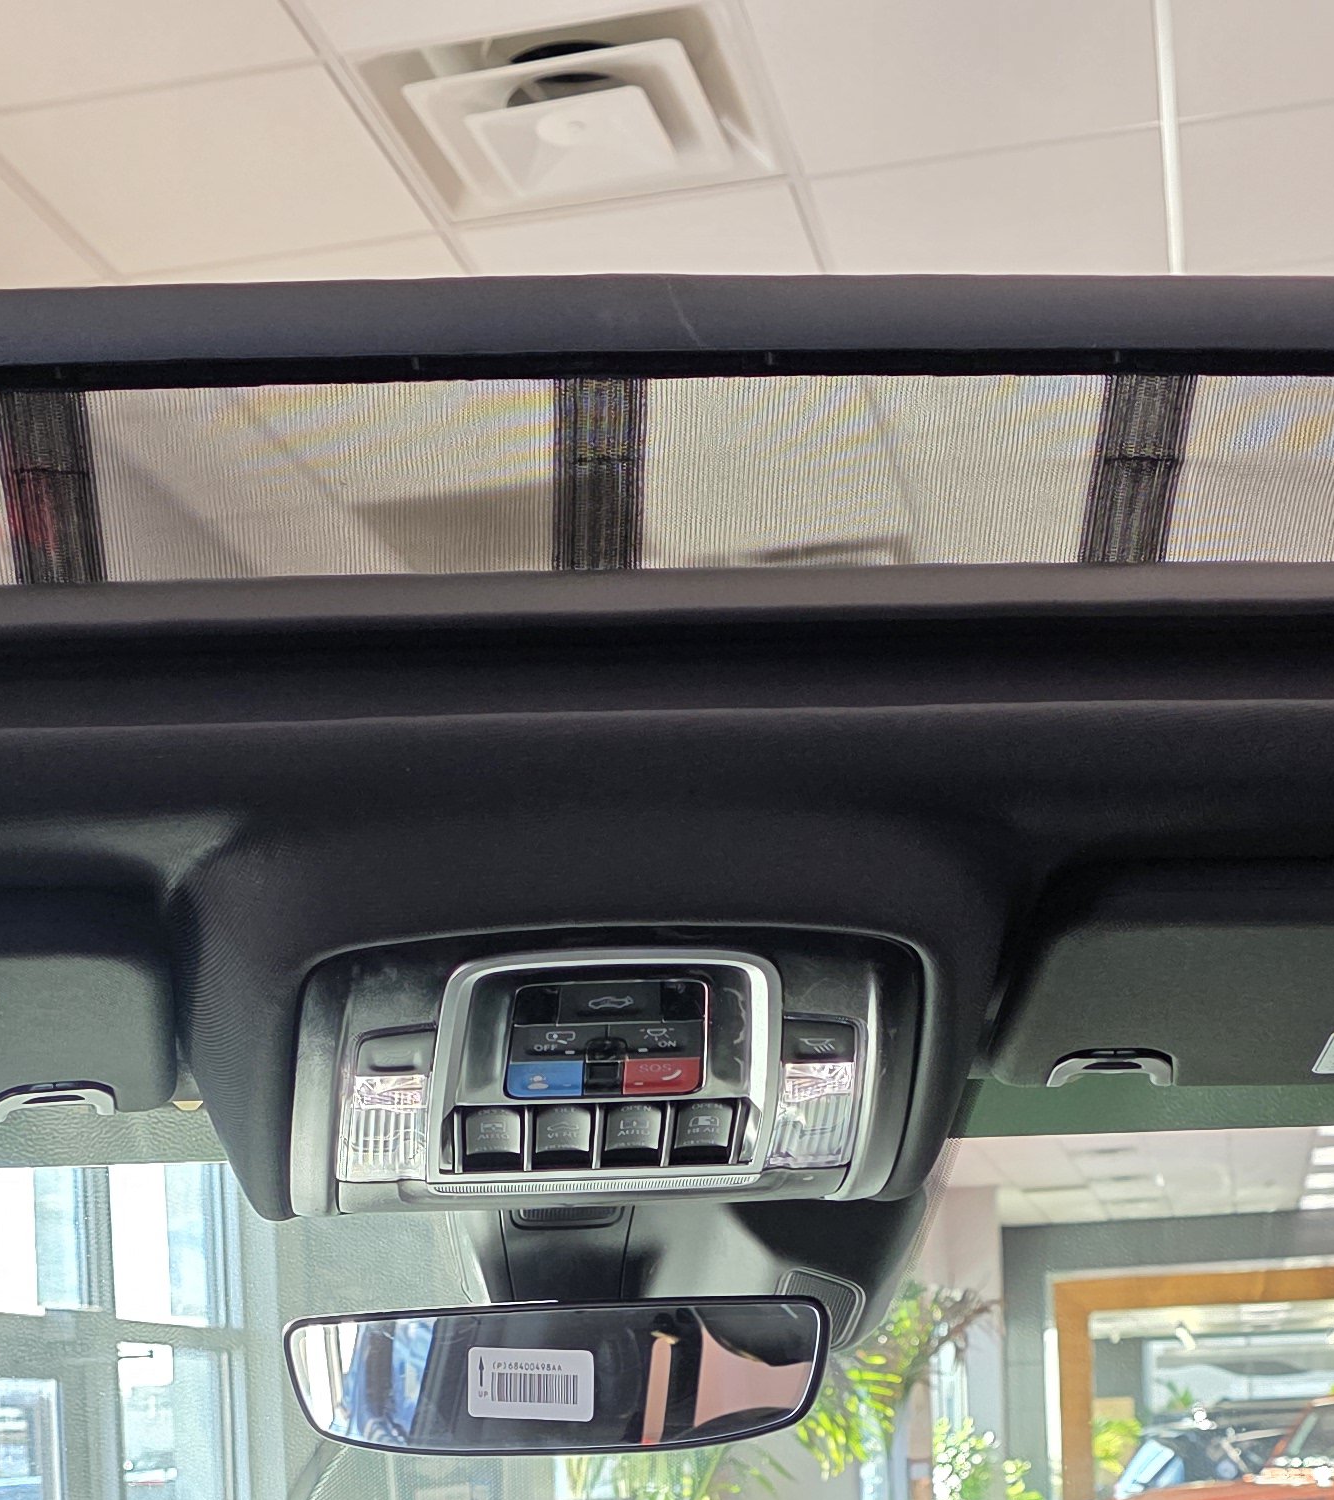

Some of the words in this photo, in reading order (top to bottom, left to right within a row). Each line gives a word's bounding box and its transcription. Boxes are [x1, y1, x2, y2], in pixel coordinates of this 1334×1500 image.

[533, 1043, 559, 1052] OFF
[658, 1039, 678, 1048] ON
[639, 1063, 672, 1073] SOS
[620, 1104, 652, 1113] OPEN
[691, 1102, 724, 1110] OPEN
[617, 1128, 651, 1137] AUTO
[478, 1390, 489, 1398] UP
